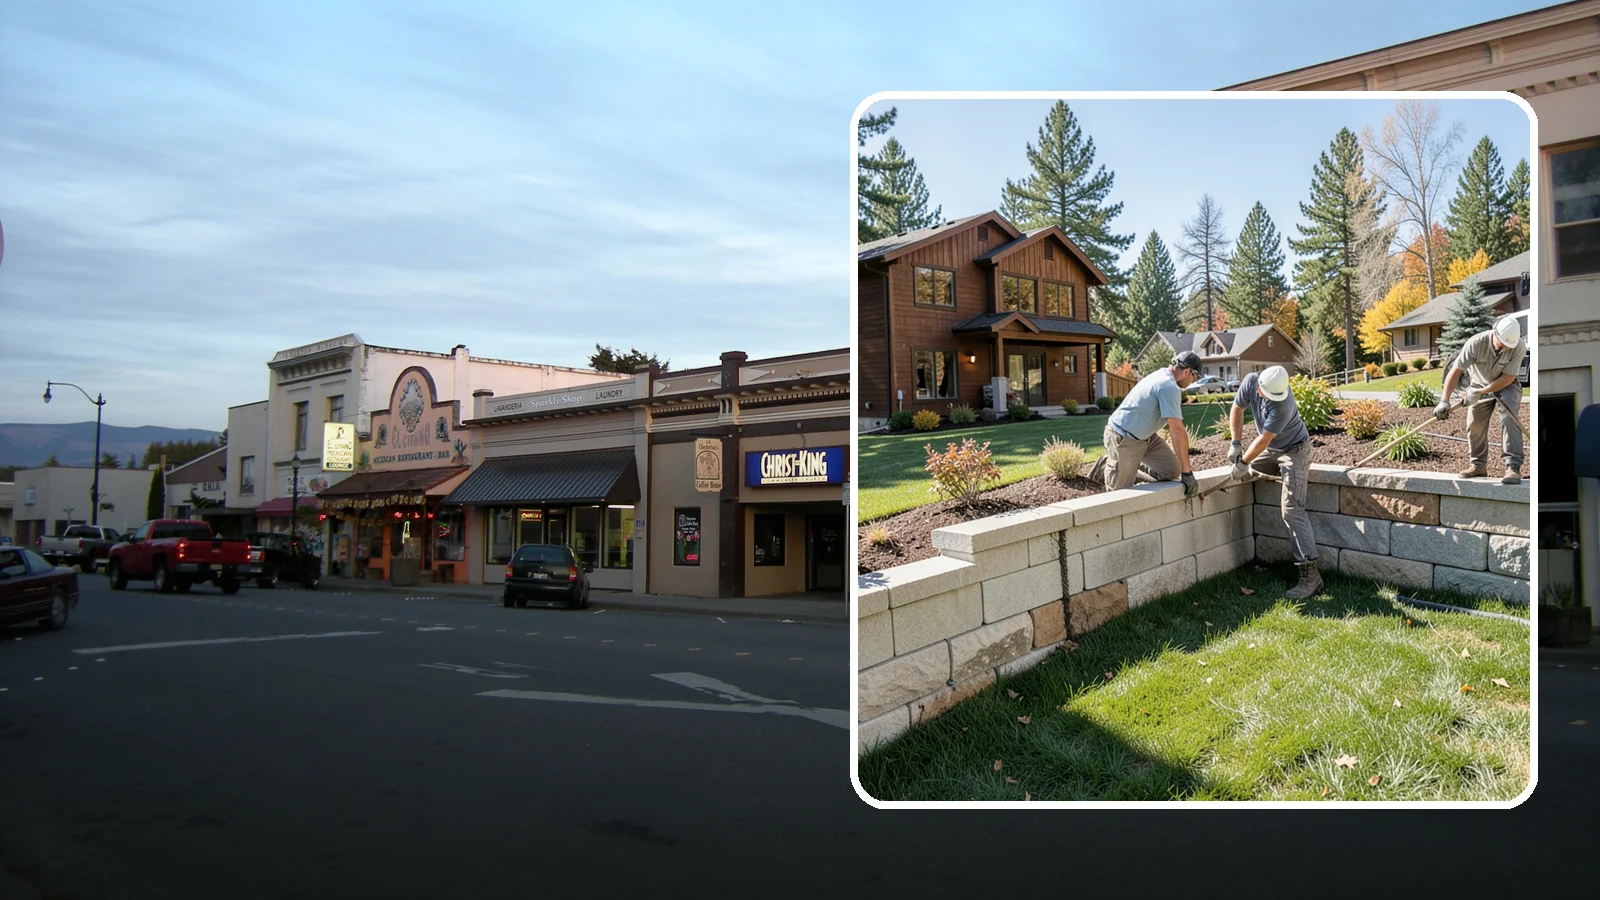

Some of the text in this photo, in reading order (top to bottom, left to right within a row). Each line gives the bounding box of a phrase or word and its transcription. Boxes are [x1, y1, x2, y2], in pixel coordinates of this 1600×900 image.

[530, 394, 583, 409] Sparkle Shop
[595, 389, 623, 400] LAUNDRY
[493, 402, 523, 413] LAVANDERIA
[373, 454, 396, 464] MEXICAN
[397, 451, 433, 462] RESTAURANT
[438, 449, 450, 459] BAR
[761, 450, 827, 478] CHRIST KING
